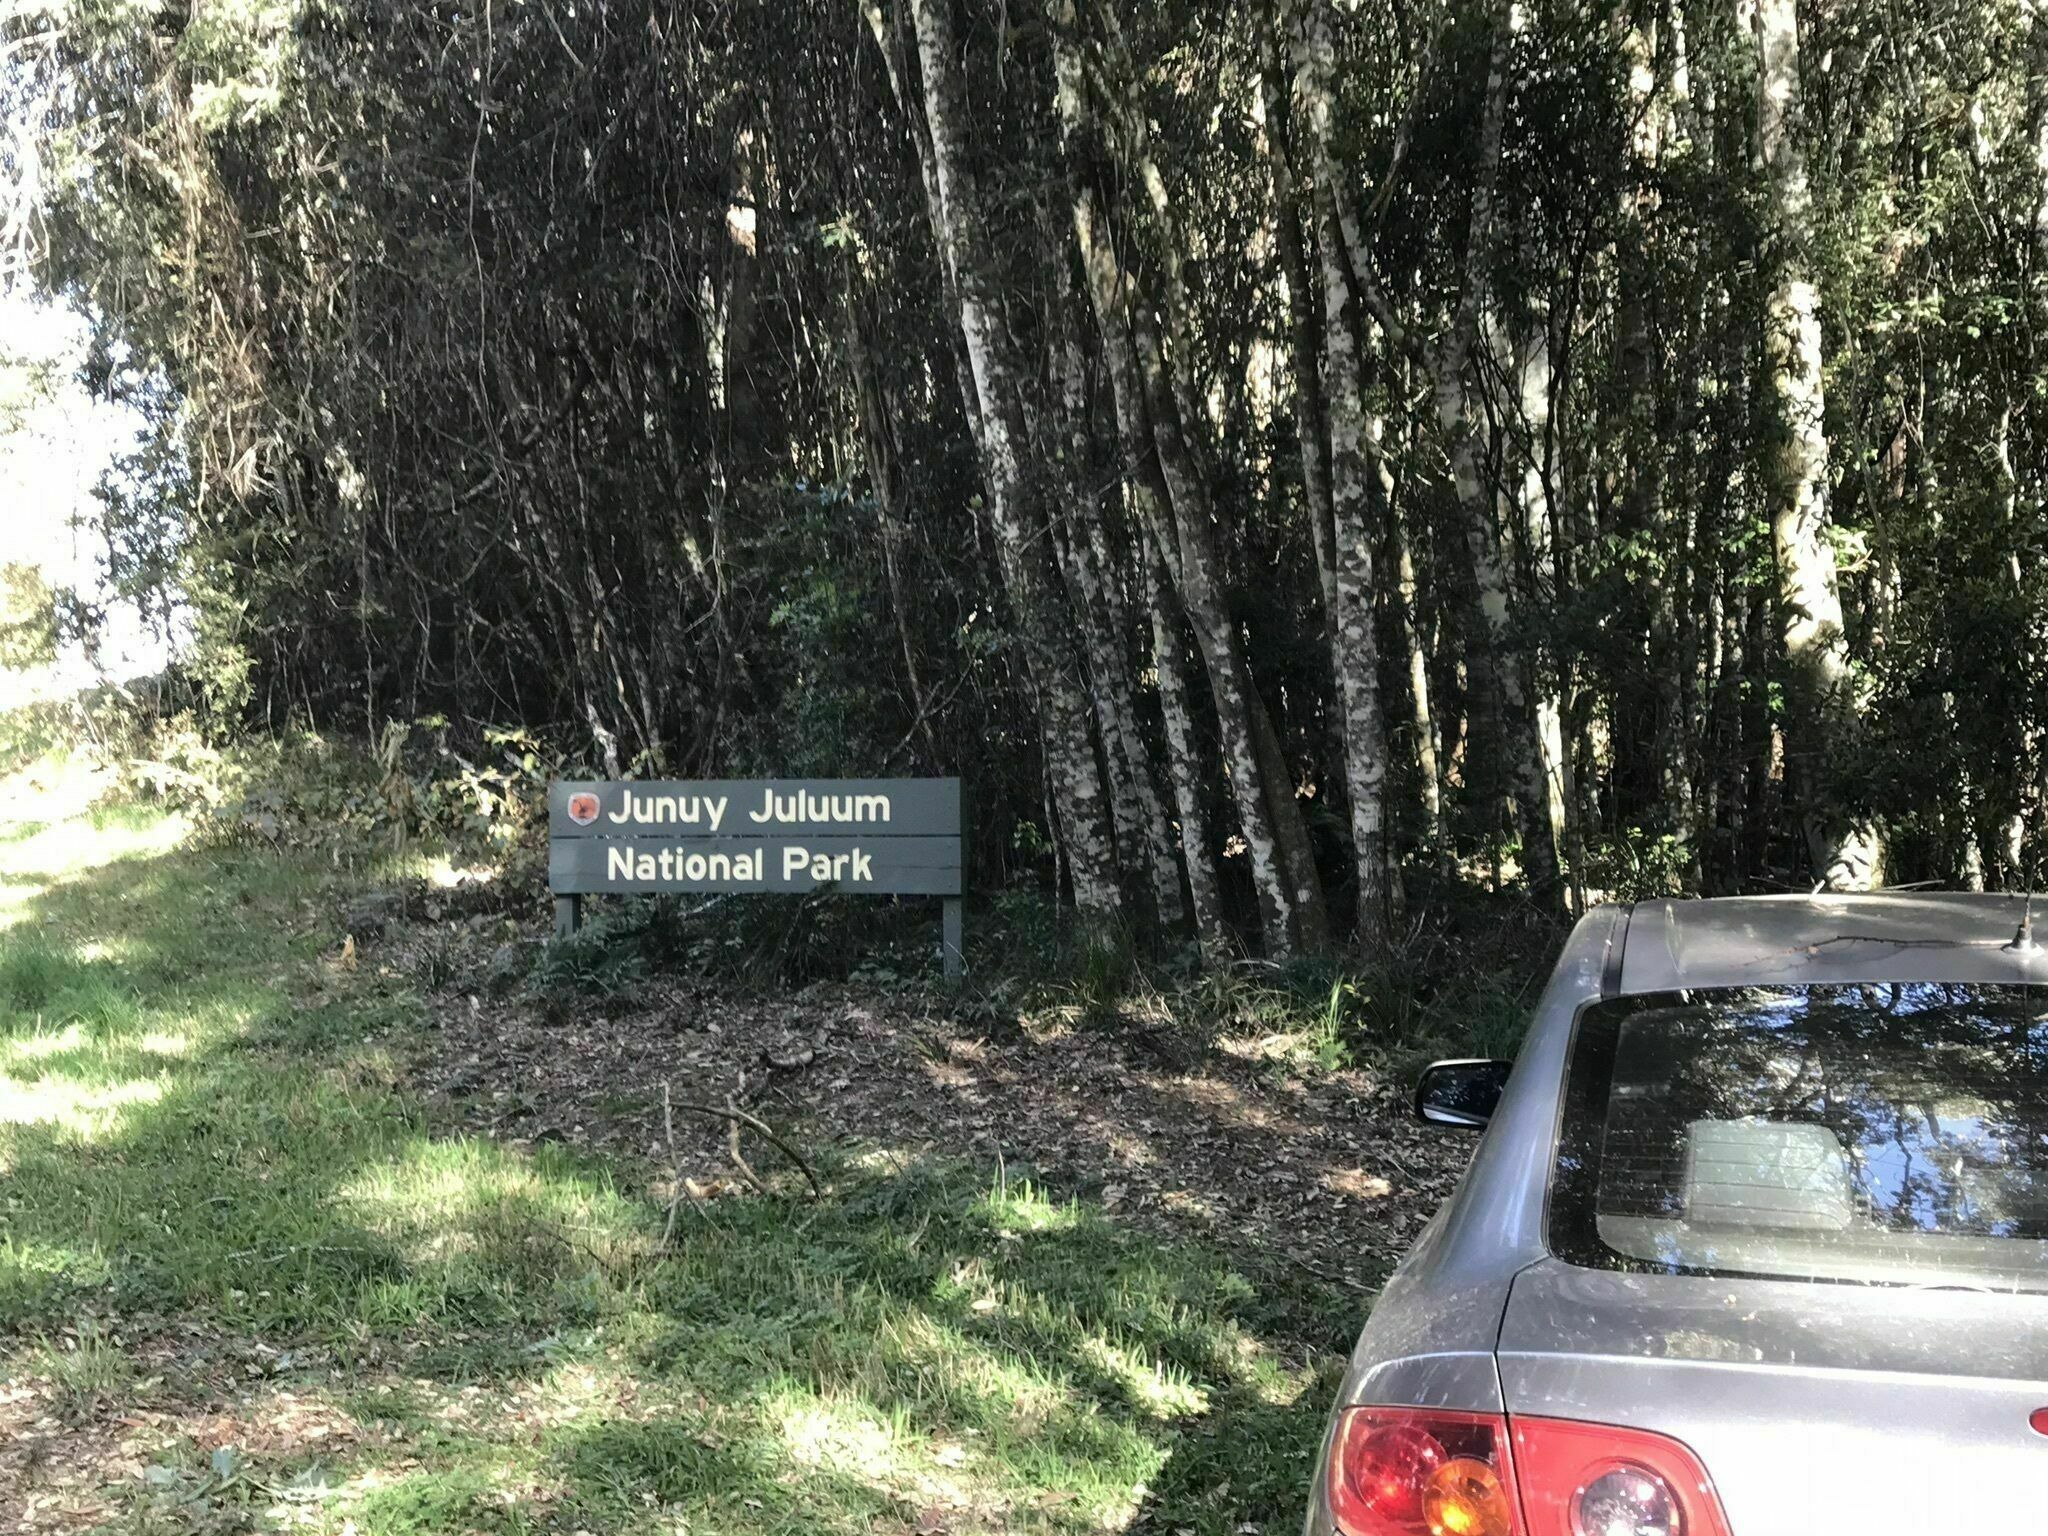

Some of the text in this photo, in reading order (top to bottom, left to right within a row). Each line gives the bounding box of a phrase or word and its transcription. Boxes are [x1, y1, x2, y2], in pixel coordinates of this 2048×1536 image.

[608, 789, 890, 831] Junuy Juluum
[608, 847, 873, 881] National Park
